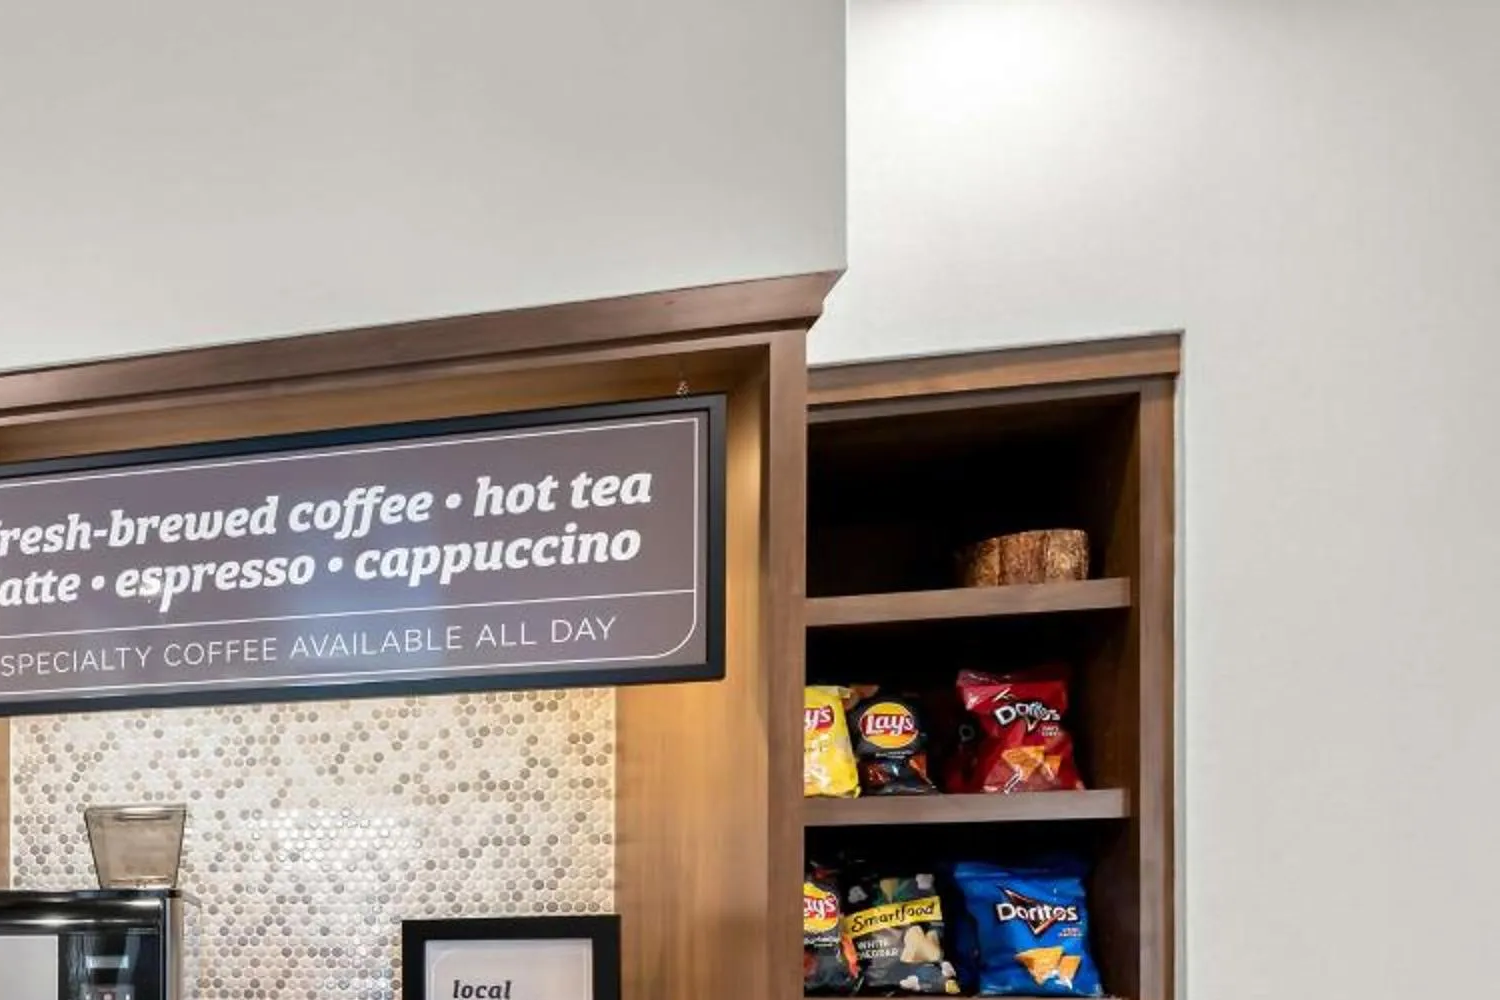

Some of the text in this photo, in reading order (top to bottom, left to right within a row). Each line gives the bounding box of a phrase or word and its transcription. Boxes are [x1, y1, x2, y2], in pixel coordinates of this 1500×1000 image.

[288, 484, 433, 541] coffee
[475, 471, 556, 517] hot
[568, 466, 652, 508] tea
[115, 549, 317, 613] espresso
[354, 525, 642, 587] cappuccino
[0, 615, 617, 679] SPECIALTY COFFEE AVAILABLE ALL DAY
[851, 902, 935, 932] Smartfood
[996, 903, 1079, 921] Doritos
[453, 979, 511, 1000] local
